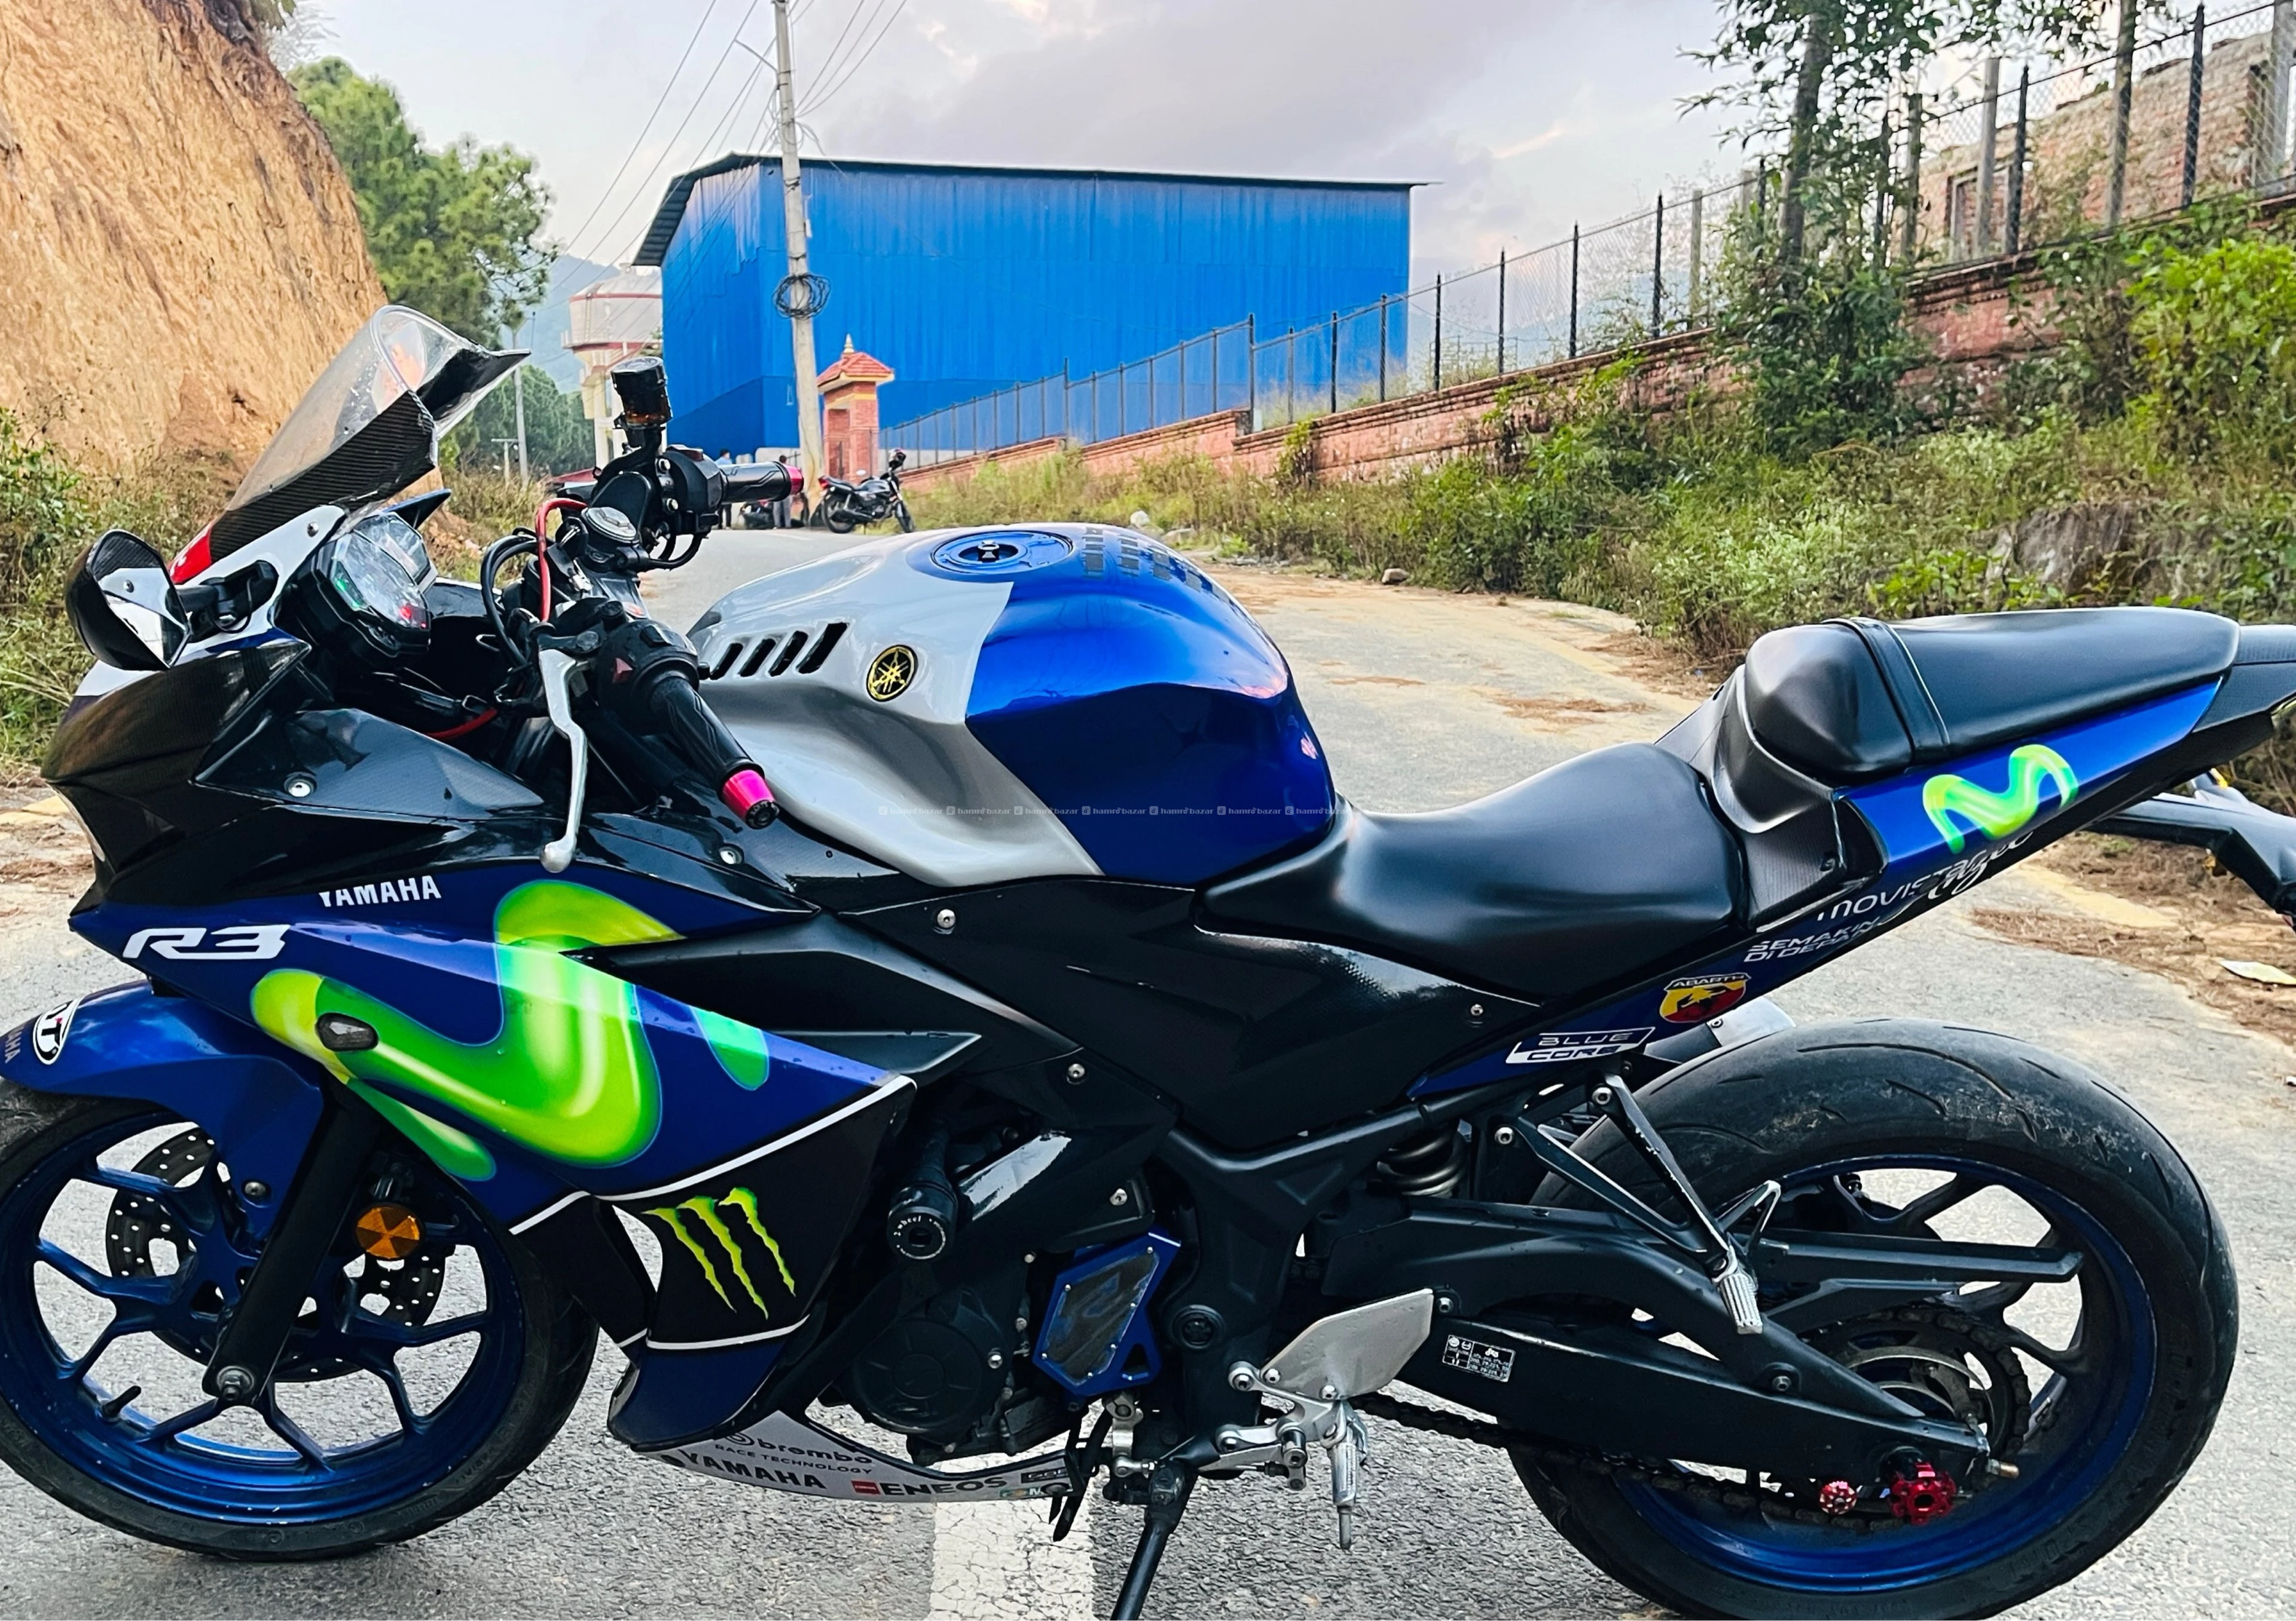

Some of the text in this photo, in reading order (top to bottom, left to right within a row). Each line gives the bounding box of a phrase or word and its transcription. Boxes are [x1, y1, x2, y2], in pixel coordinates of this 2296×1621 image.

[319, 875, 441, 907] YAMAHA
[123, 924, 291, 959] R3
[1527, 1045, 1622, 1061] CORE
[1538, 1033, 1633, 1046] BLUE
[715, 1444, 872, 1475] RACE TECHNOLOGY
[758, 1436, 873, 1464] brembo
[677, 1449, 828, 1489] YAMAHA
[878, 1476, 1007, 1495] ENEOS
